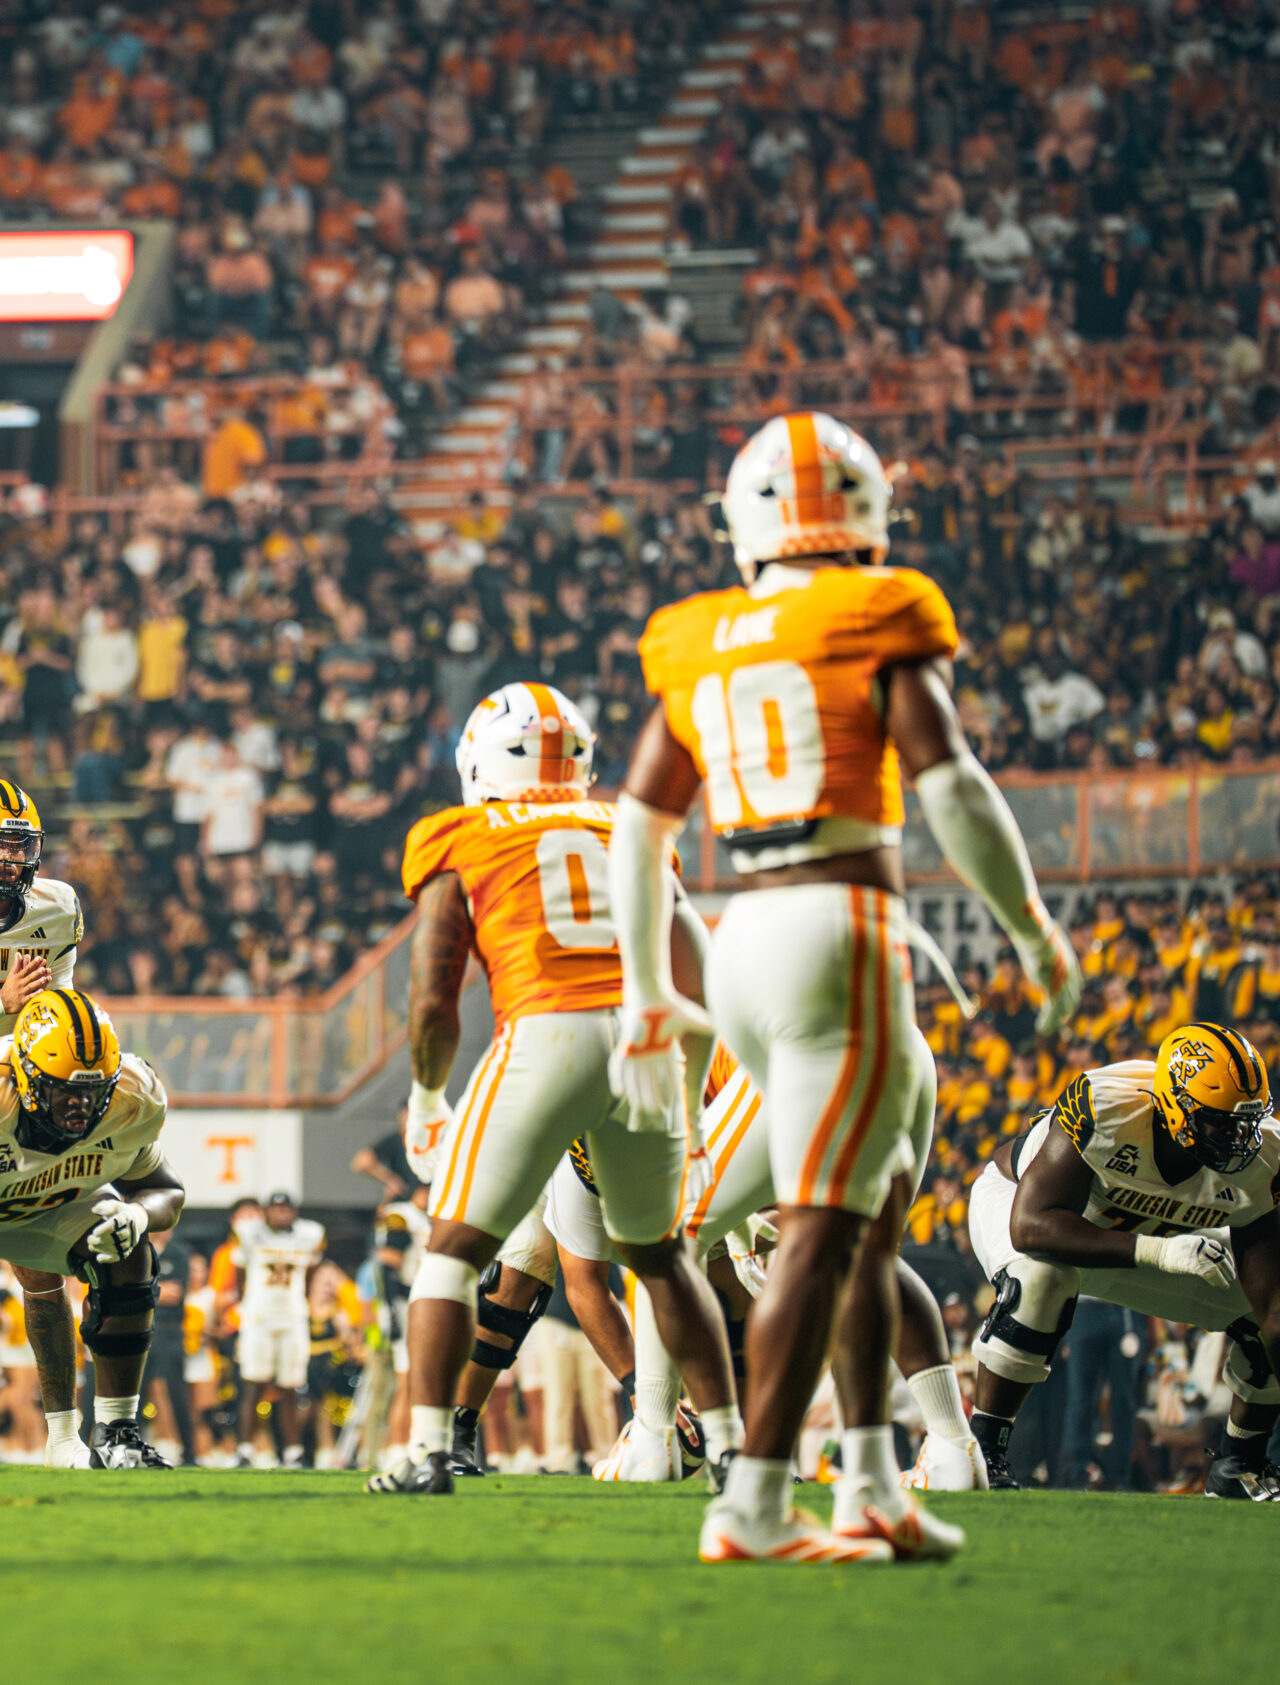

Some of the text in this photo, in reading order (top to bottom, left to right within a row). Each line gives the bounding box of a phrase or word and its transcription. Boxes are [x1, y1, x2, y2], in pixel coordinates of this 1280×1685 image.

[691, 659, 825, 825] 10
[535, 828, 616, 949] 0
[0, 1153, 104, 1199] KENNESAW STATE
[1104, 1157, 1139, 1177] USA
[1106, 1186, 1231, 1228] KENNESAW STATE
